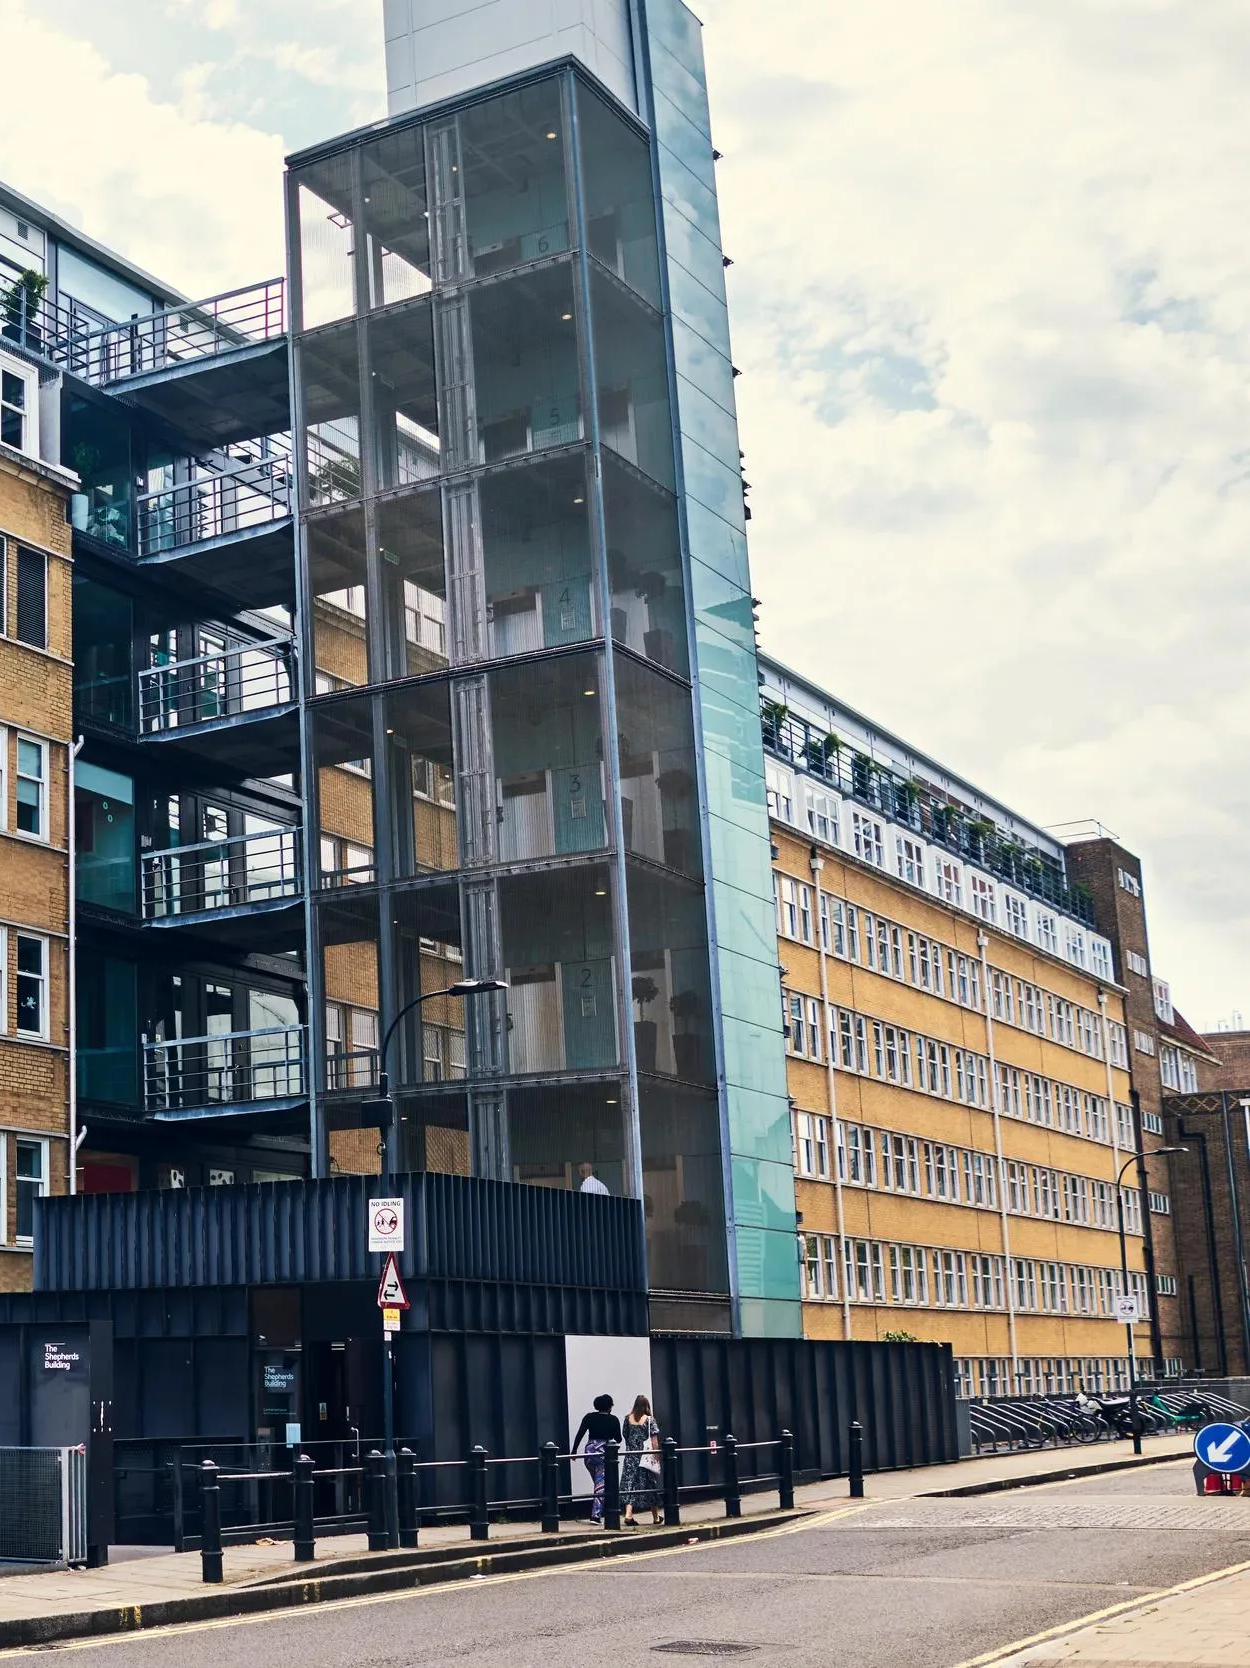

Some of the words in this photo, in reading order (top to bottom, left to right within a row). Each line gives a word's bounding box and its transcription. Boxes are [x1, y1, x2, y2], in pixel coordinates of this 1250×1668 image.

[538, 235, 549, 253] 6
[550, 408, 560, 426] 5
[559, 587, 571, 604] 4
[570, 774, 581, 793] 3
[581, 968, 592, 987] 2
[44, 1344, 58, 1352] The
[44, 1352, 80, 1361] Shepherds
[44, 1361, 71, 1370] Building
[264, 1373, 294, 1381] Shepherds
[264, 1380, 287, 1388] Building
